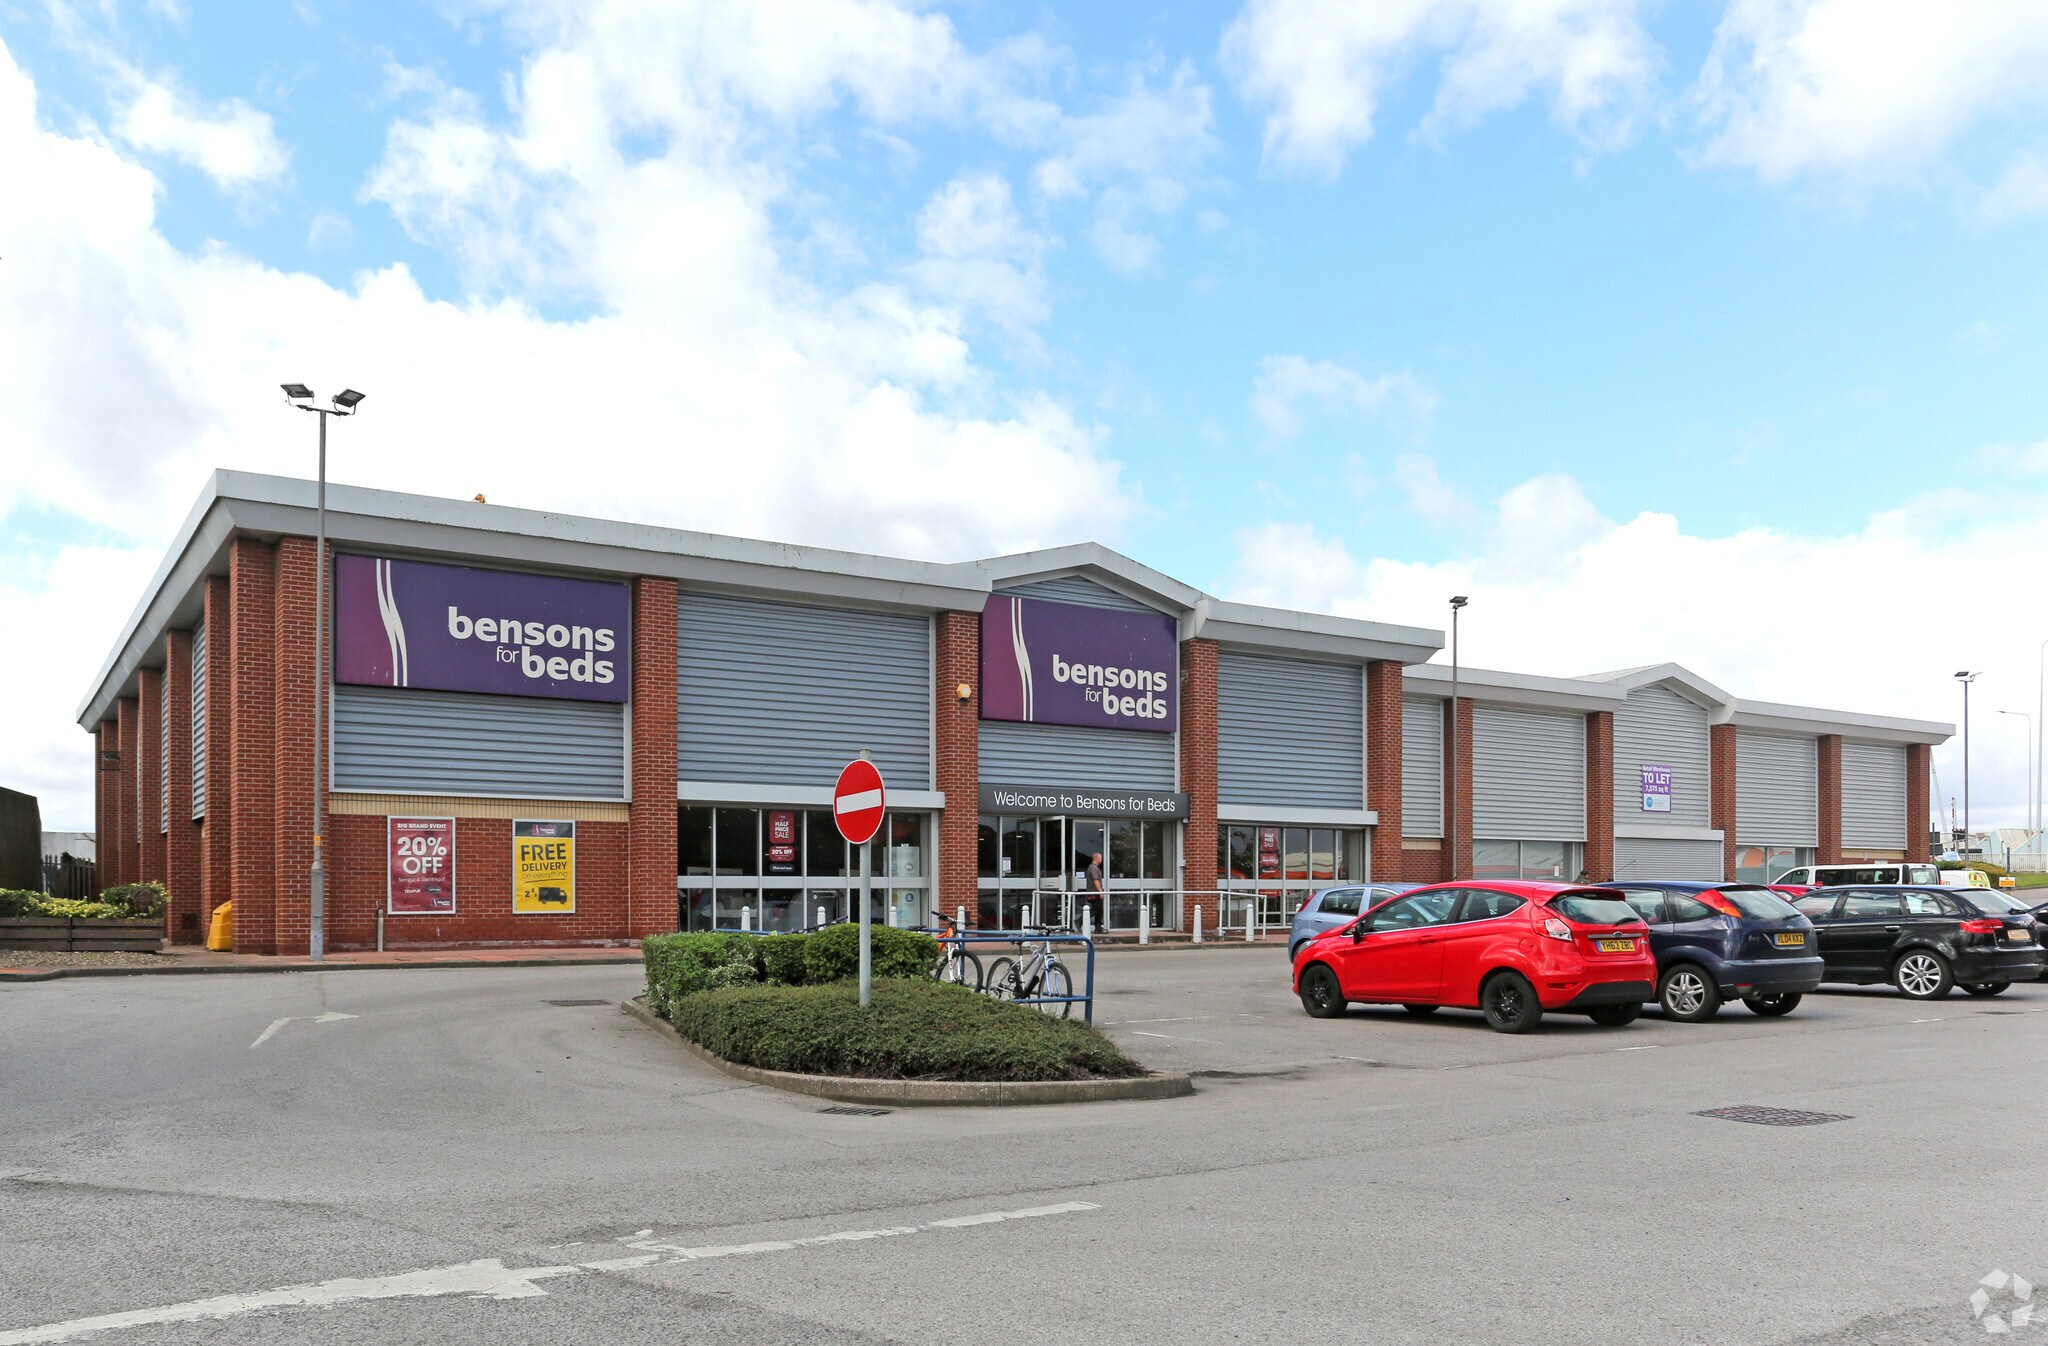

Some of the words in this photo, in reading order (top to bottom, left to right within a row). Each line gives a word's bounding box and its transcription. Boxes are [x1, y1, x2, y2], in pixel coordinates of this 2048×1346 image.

[448, 606, 615, 652] bensons
[496, 646, 519, 663] for
[521, 646, 615, 684] beds
[1052, 654, 1168, 692] bensons
[1085, 687, 1101, 702] for
[1102, 687, 1168, 719] beds
[1643, 773, 1654, 783] TO
[1656, 773, 1670, 784] LET
[994, 791, 1057, 808] Welcome
[1060, 794, 1073, 808] to
[1076, 794, 1126, 811] Bensons
[1128, 797, 1144, 811] for
[1147, 798, 1176, 812] Beds
[397, 836, 447, 856] 20%
[521, 843, 567, 861] FREE
[402, 856, 443, 875] OFF
[522, 861, 567, 872] DELIVERY
[533, 871, 567, 879] everything
